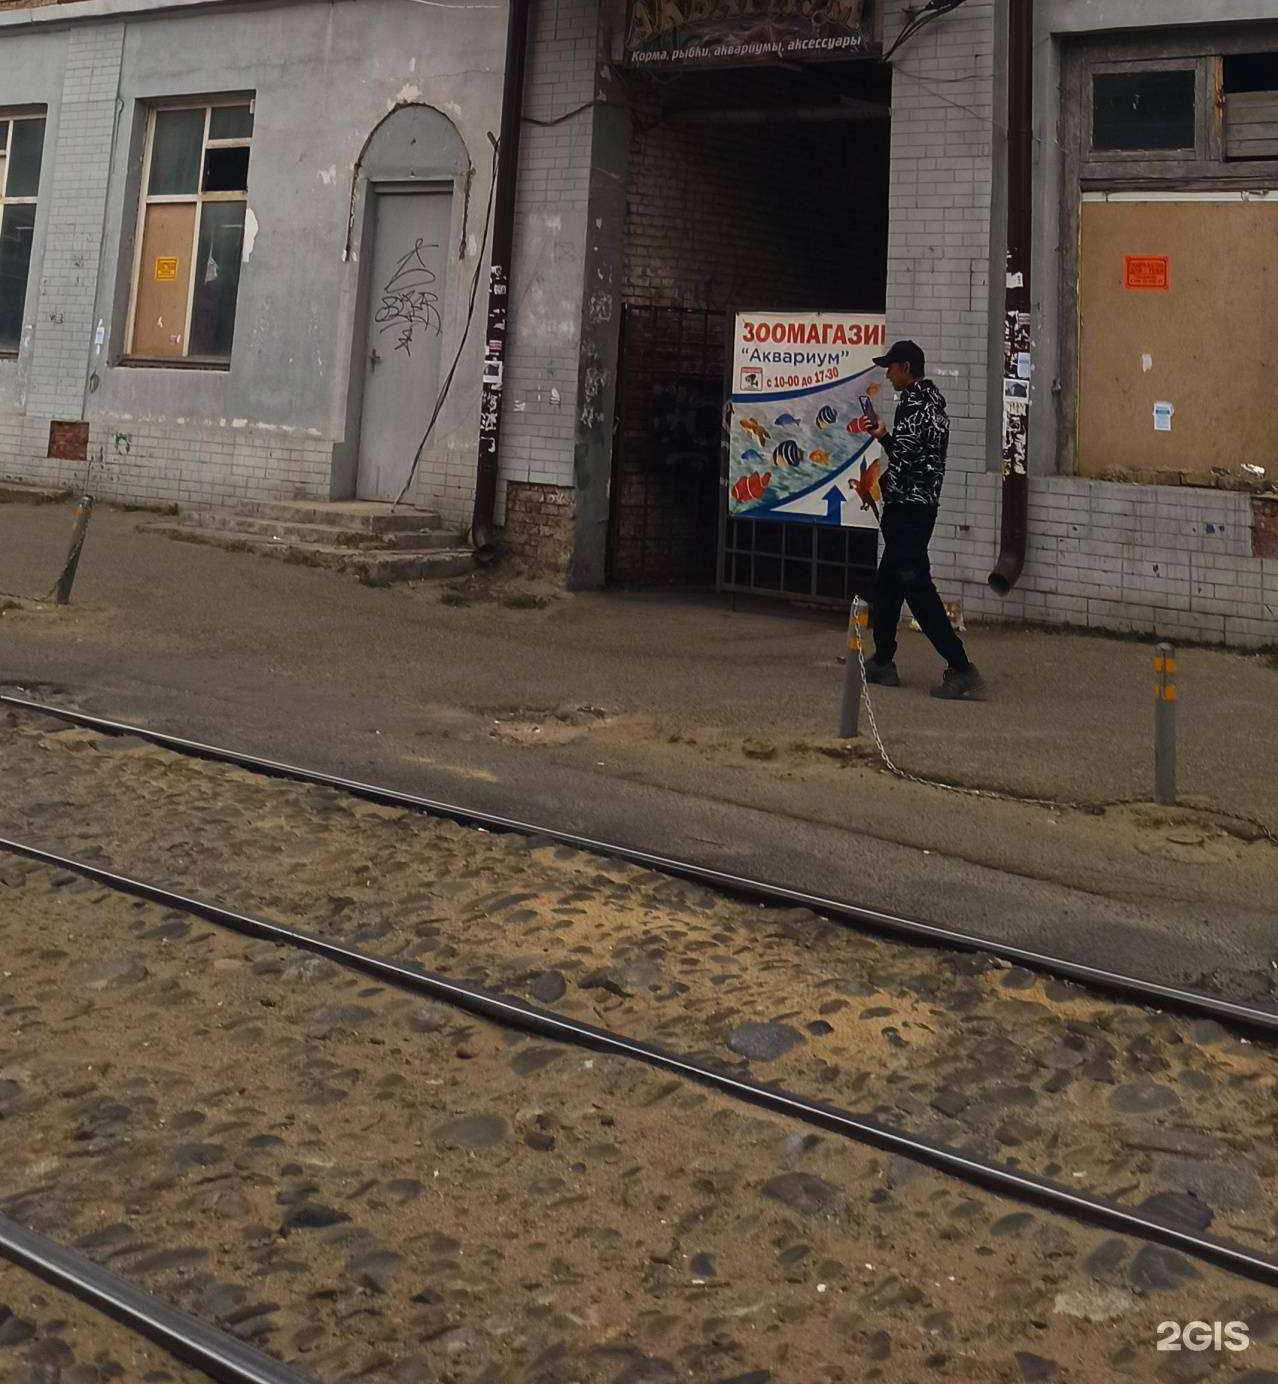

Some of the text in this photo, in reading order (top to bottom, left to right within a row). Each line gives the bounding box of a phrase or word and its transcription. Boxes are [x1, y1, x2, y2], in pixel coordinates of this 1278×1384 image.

[631, 50, 669, 63] Корма,
[671, 46, 711, 61] рыбки,
[787, 36, 862, 51] аксессуары
[742, 322, 886, 345] ЗООМАГАЗИ
[766, 366, 839, 388] с 10-00 до 17-30
